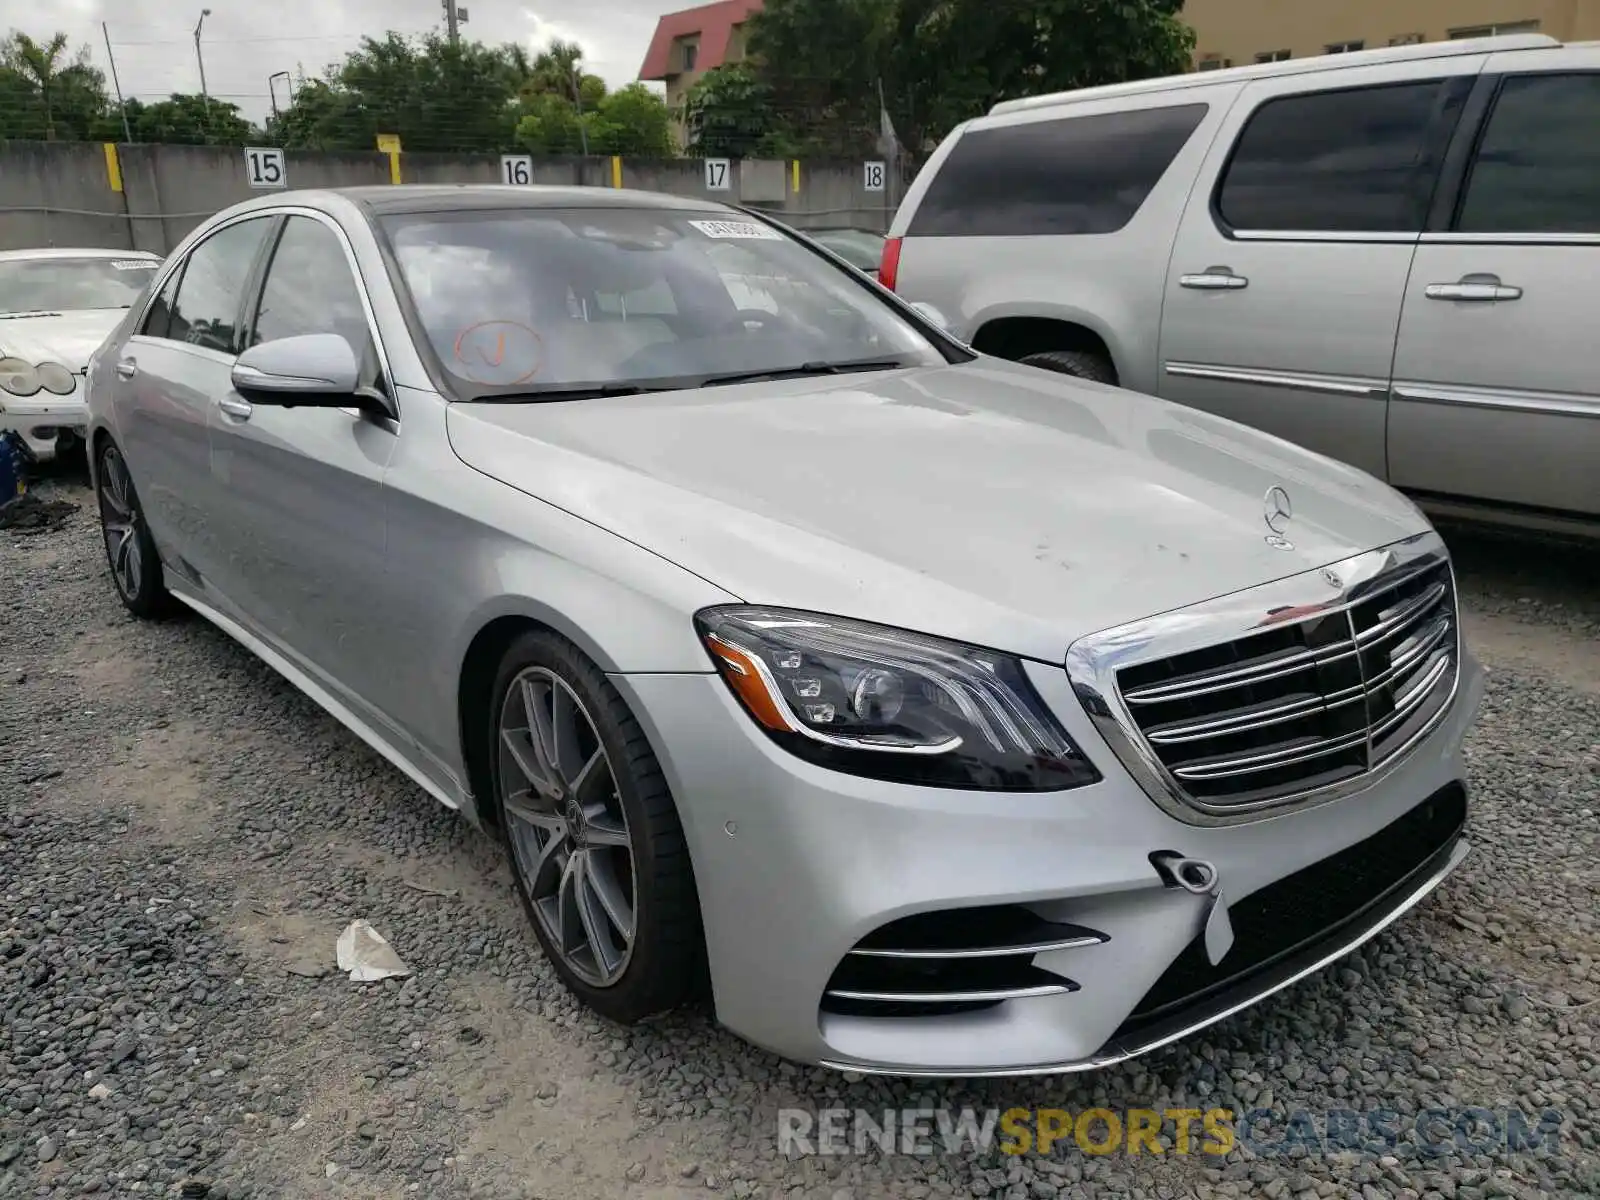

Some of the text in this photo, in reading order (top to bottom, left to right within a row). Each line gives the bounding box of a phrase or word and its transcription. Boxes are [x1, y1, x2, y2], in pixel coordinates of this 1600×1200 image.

[250, 153, 280, 182] 15
[505, 160, 529, 185] 16
[709, 163, 726, 187] 17
[867, 166, 882, 187] 18
